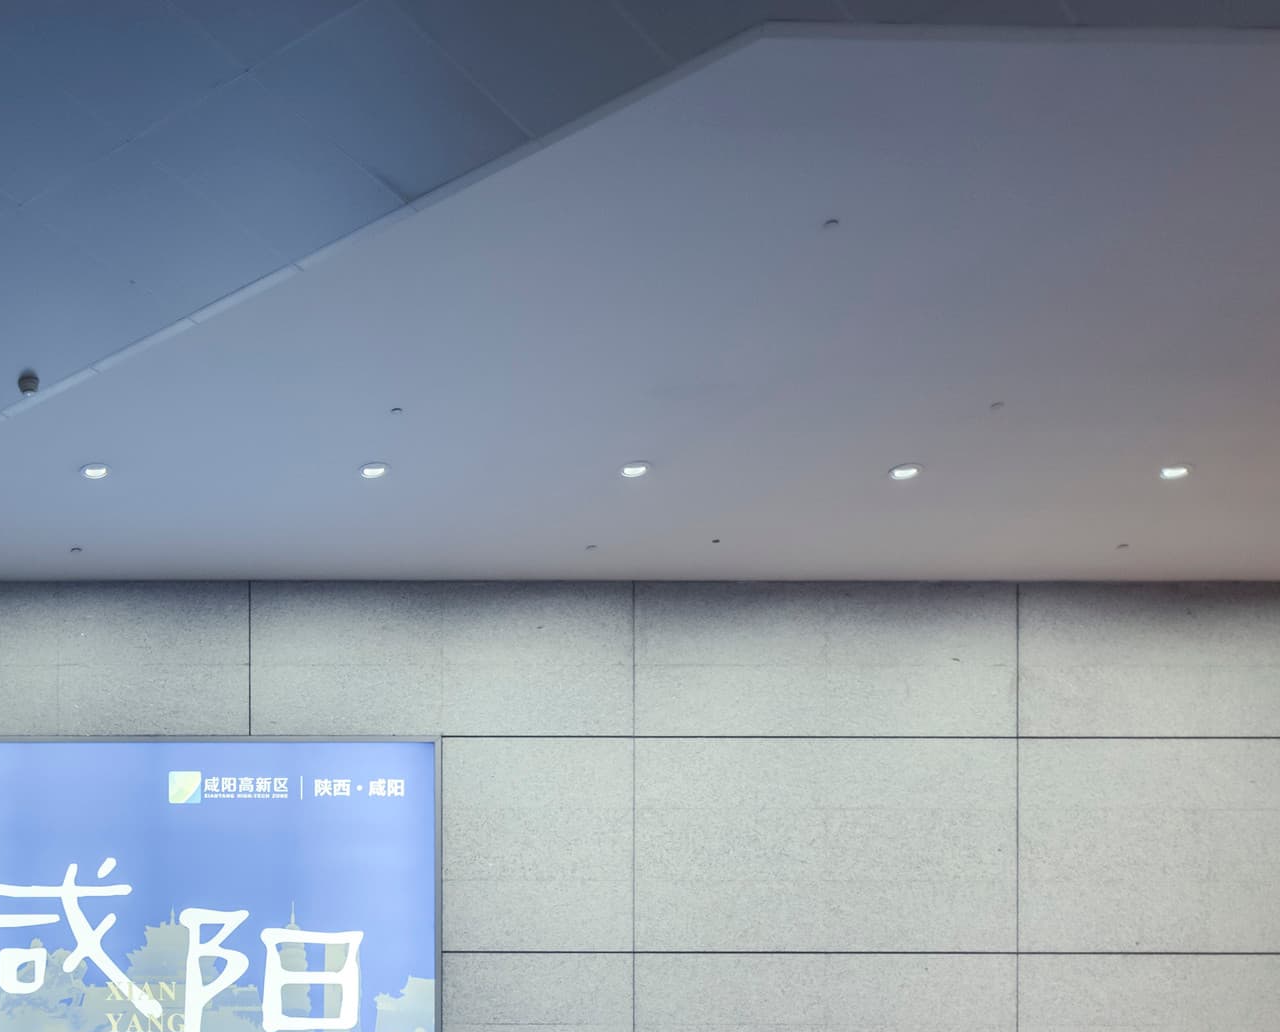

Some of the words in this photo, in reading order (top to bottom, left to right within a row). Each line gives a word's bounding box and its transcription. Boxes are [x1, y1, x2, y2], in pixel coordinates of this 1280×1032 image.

[204, 776, 289, 793] 咸阳高新区
[105, 981, 176, 1001] XIAN
[106, 1013, 185, 1032] YANG
